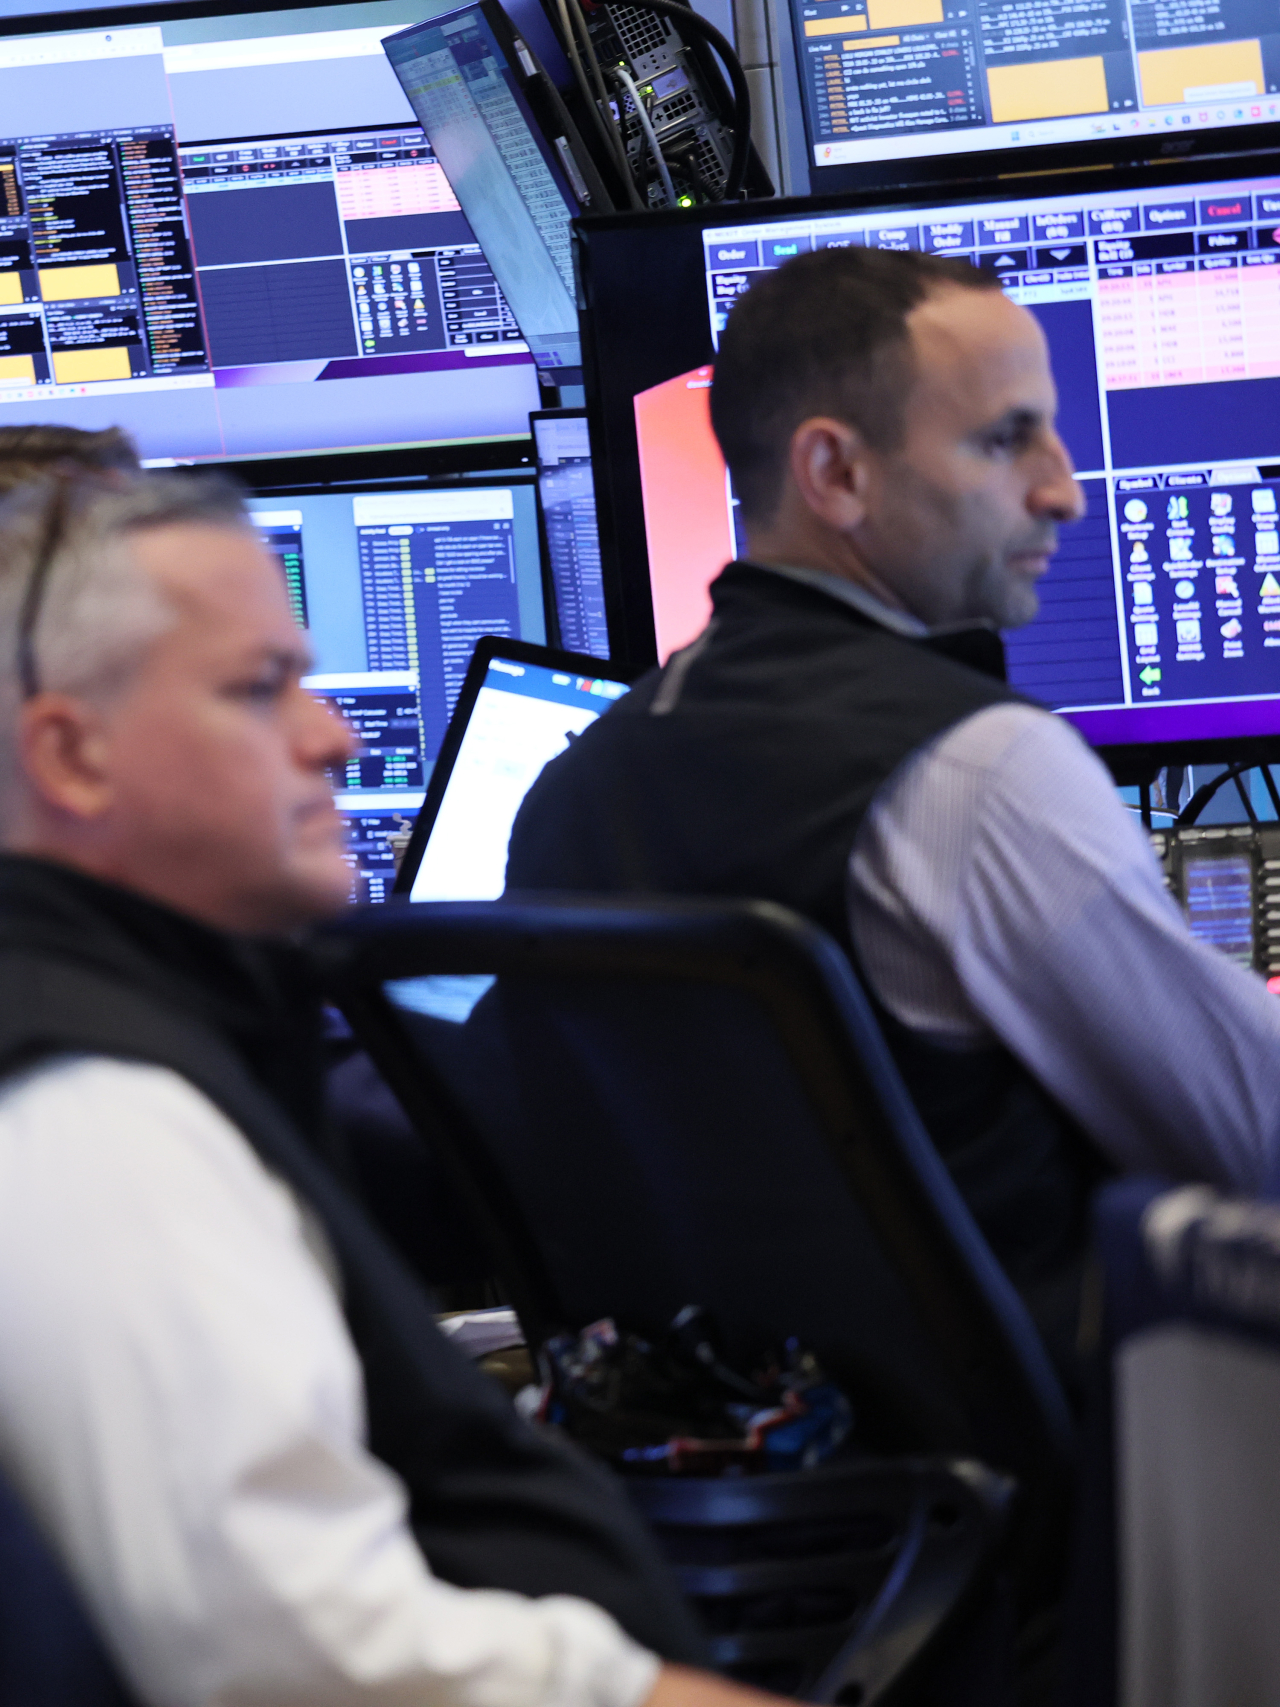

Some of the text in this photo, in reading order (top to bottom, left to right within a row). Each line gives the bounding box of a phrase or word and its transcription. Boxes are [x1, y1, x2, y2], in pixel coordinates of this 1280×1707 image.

[1207, 202, 1242, 217] Cancel
[717, 248, 746, 261] Order
[773, 243, 797, 256] Send
